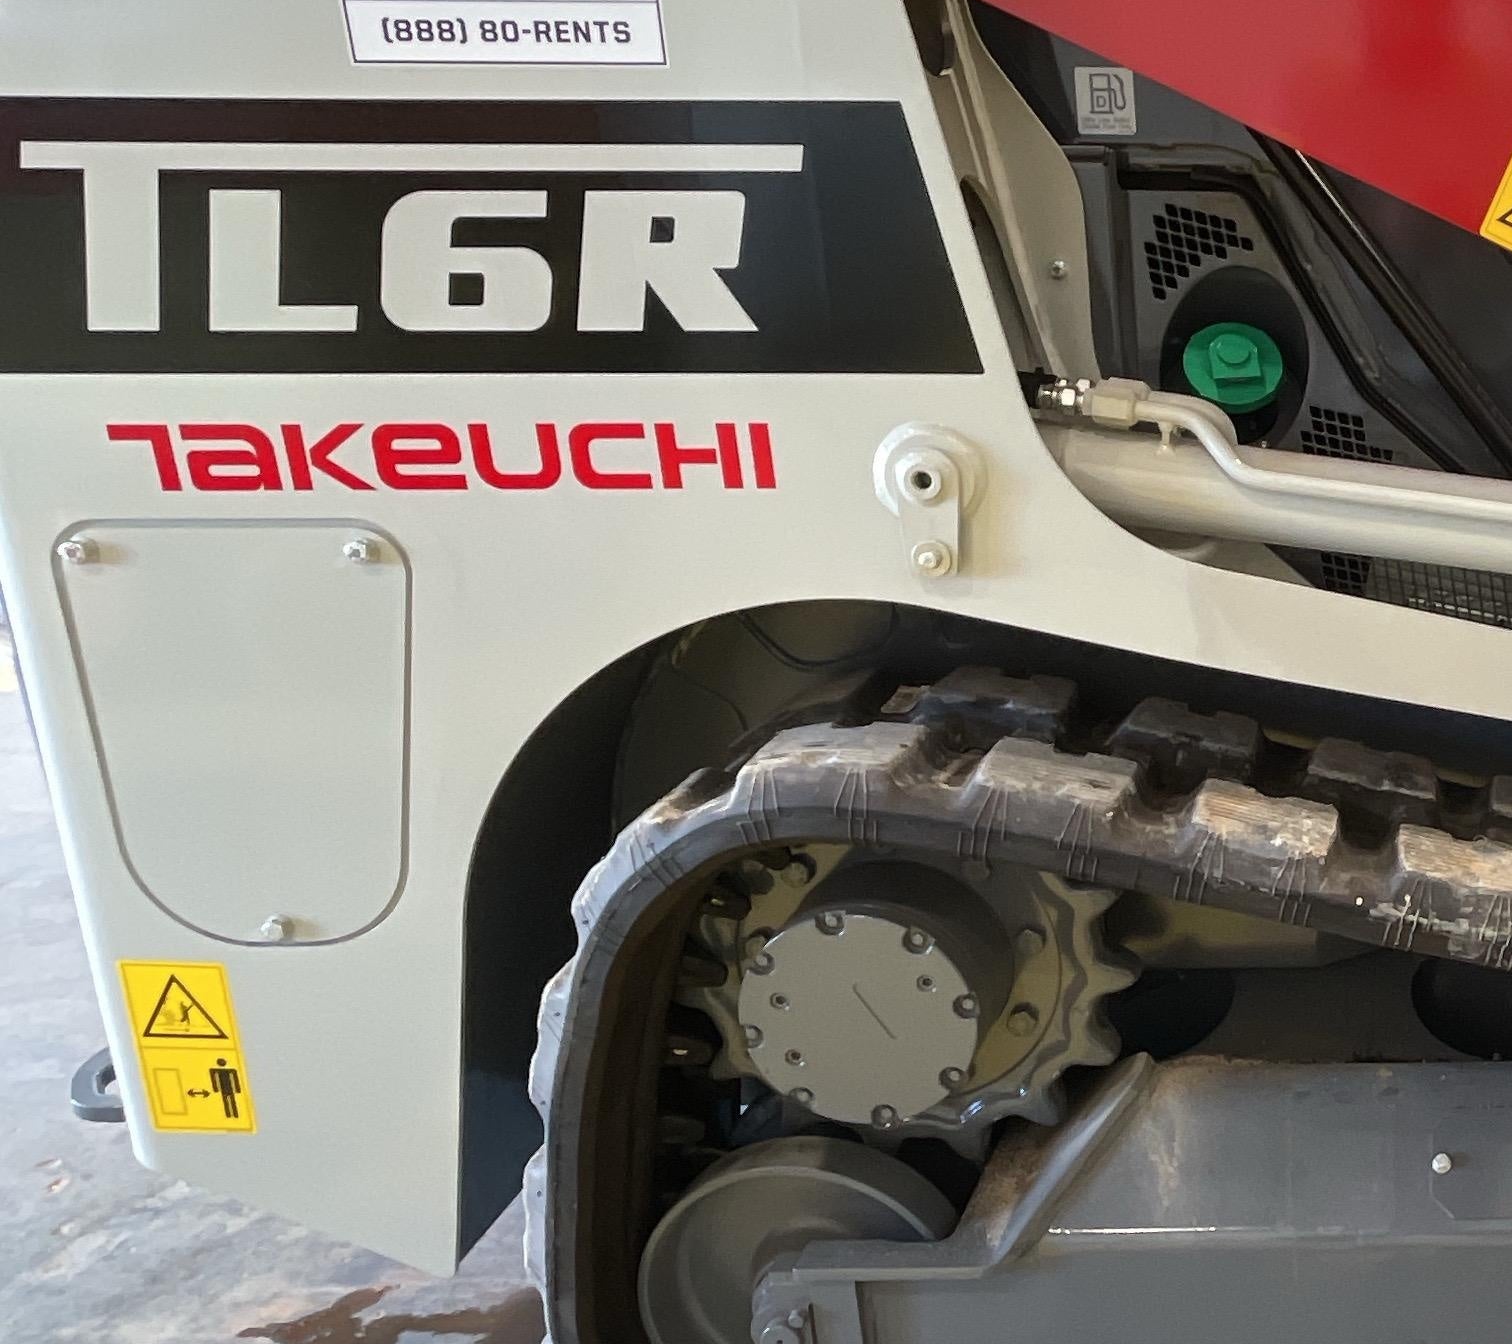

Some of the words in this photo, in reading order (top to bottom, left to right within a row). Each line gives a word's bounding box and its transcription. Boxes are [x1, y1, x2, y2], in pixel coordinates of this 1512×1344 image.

[381, 17, 469, 46] (888)
[478, 20, 632, 45] 80-RENTS
[19, 140, 805, 333] TL6R
